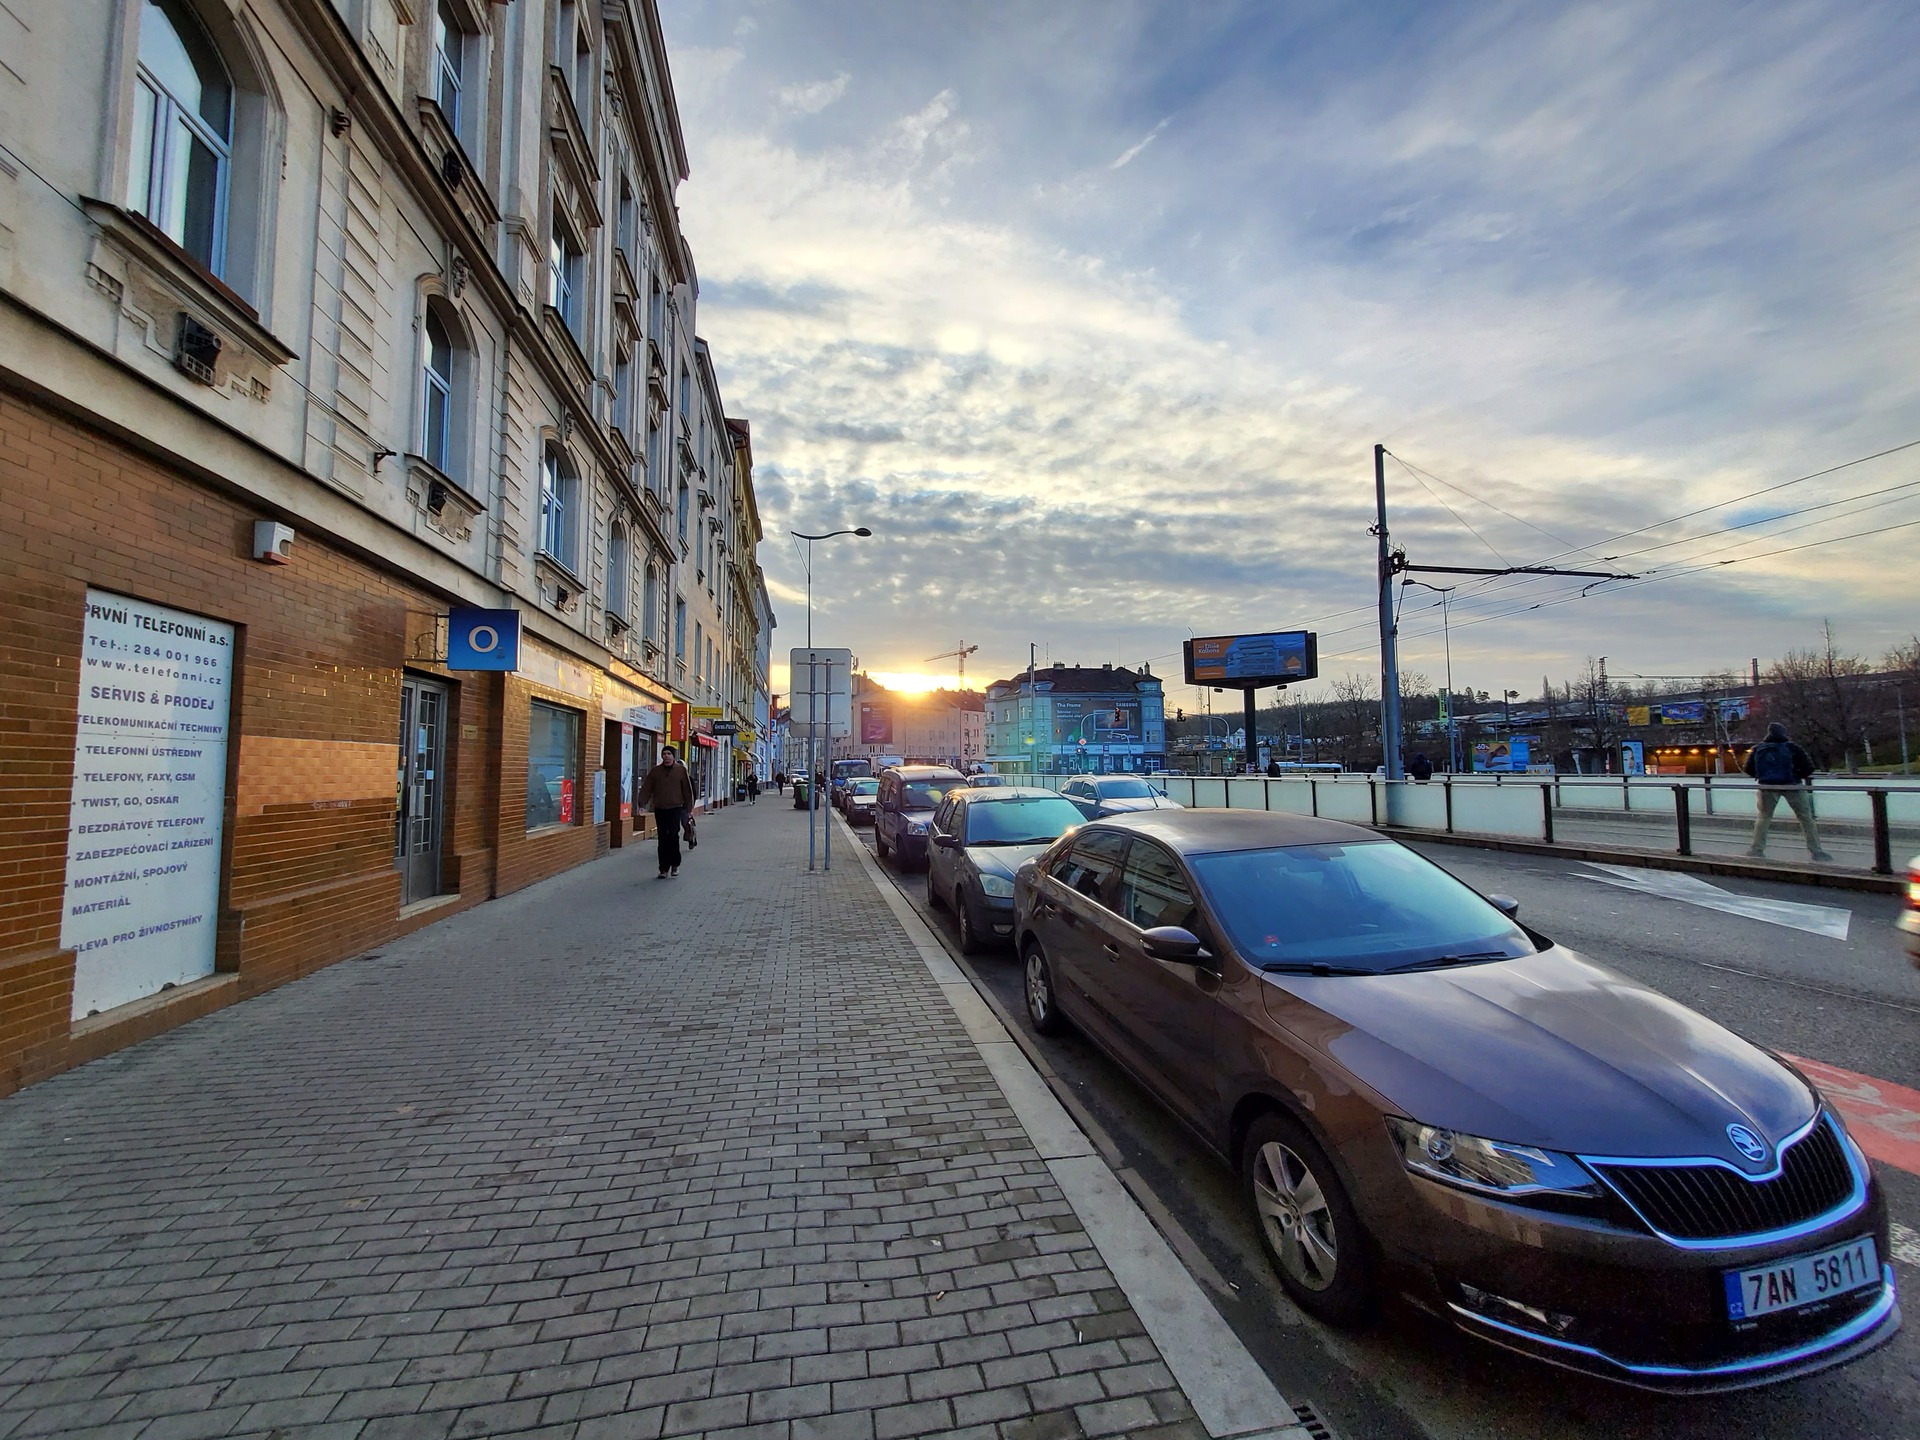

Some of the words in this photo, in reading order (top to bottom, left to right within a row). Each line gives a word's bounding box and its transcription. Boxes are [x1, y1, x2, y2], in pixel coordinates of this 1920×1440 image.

[133, 614, 206, 641] TELEFONNÍ
[209, 634, 229, 646] a.s.
[134, 644, 161, 657] 284
[165, 650, 189, 662] 001
[195, 655, 217, 667] 966
[86, 657, 222, 685] www.telefonni.cz
[90, 685, 146, 703] SERVIS
[150, 692, 160, 705] &
[164, 694, 215, 710] PRODEJ
[180, 722, 223, 734] TECHNIKY
[85, 744, 149, 756] TELEFONNÍ
[152, 745, 203, 758] ÚSTŘEDNY
[83, 773, 144, 783] TELEFONY,
[147, 773, 173, 783] FAXY,
[175, 773, 196, 782] GSM
[81, 797, 120, 808] TWIST,
[123, 797, 142, 807] GO,
[145, 796, 179, 805] OSKAR
[78, 818, 153, 834] BEZDRÁTOVÉ
[156, 816, 205, 829] TELEFONY
[75, 842, 169, 861] ZABEZPEČOVACÍ
[74, 868, 140, 889] MONTÁŽNÍ,
[142, 861, 188, 878] SPOJOVÝ
[72, 895, 131, 916] MATERIÁL
[112, 931, 136, 944] PRO
[138, 914, 203, 938] ŽIVNOSTNÍKY
[1748, 1266, 1797, 1310] 7AN
[1812, 1246, 1867, 1293] 5811
[1729, 1302, 1743, 1314] CZ
